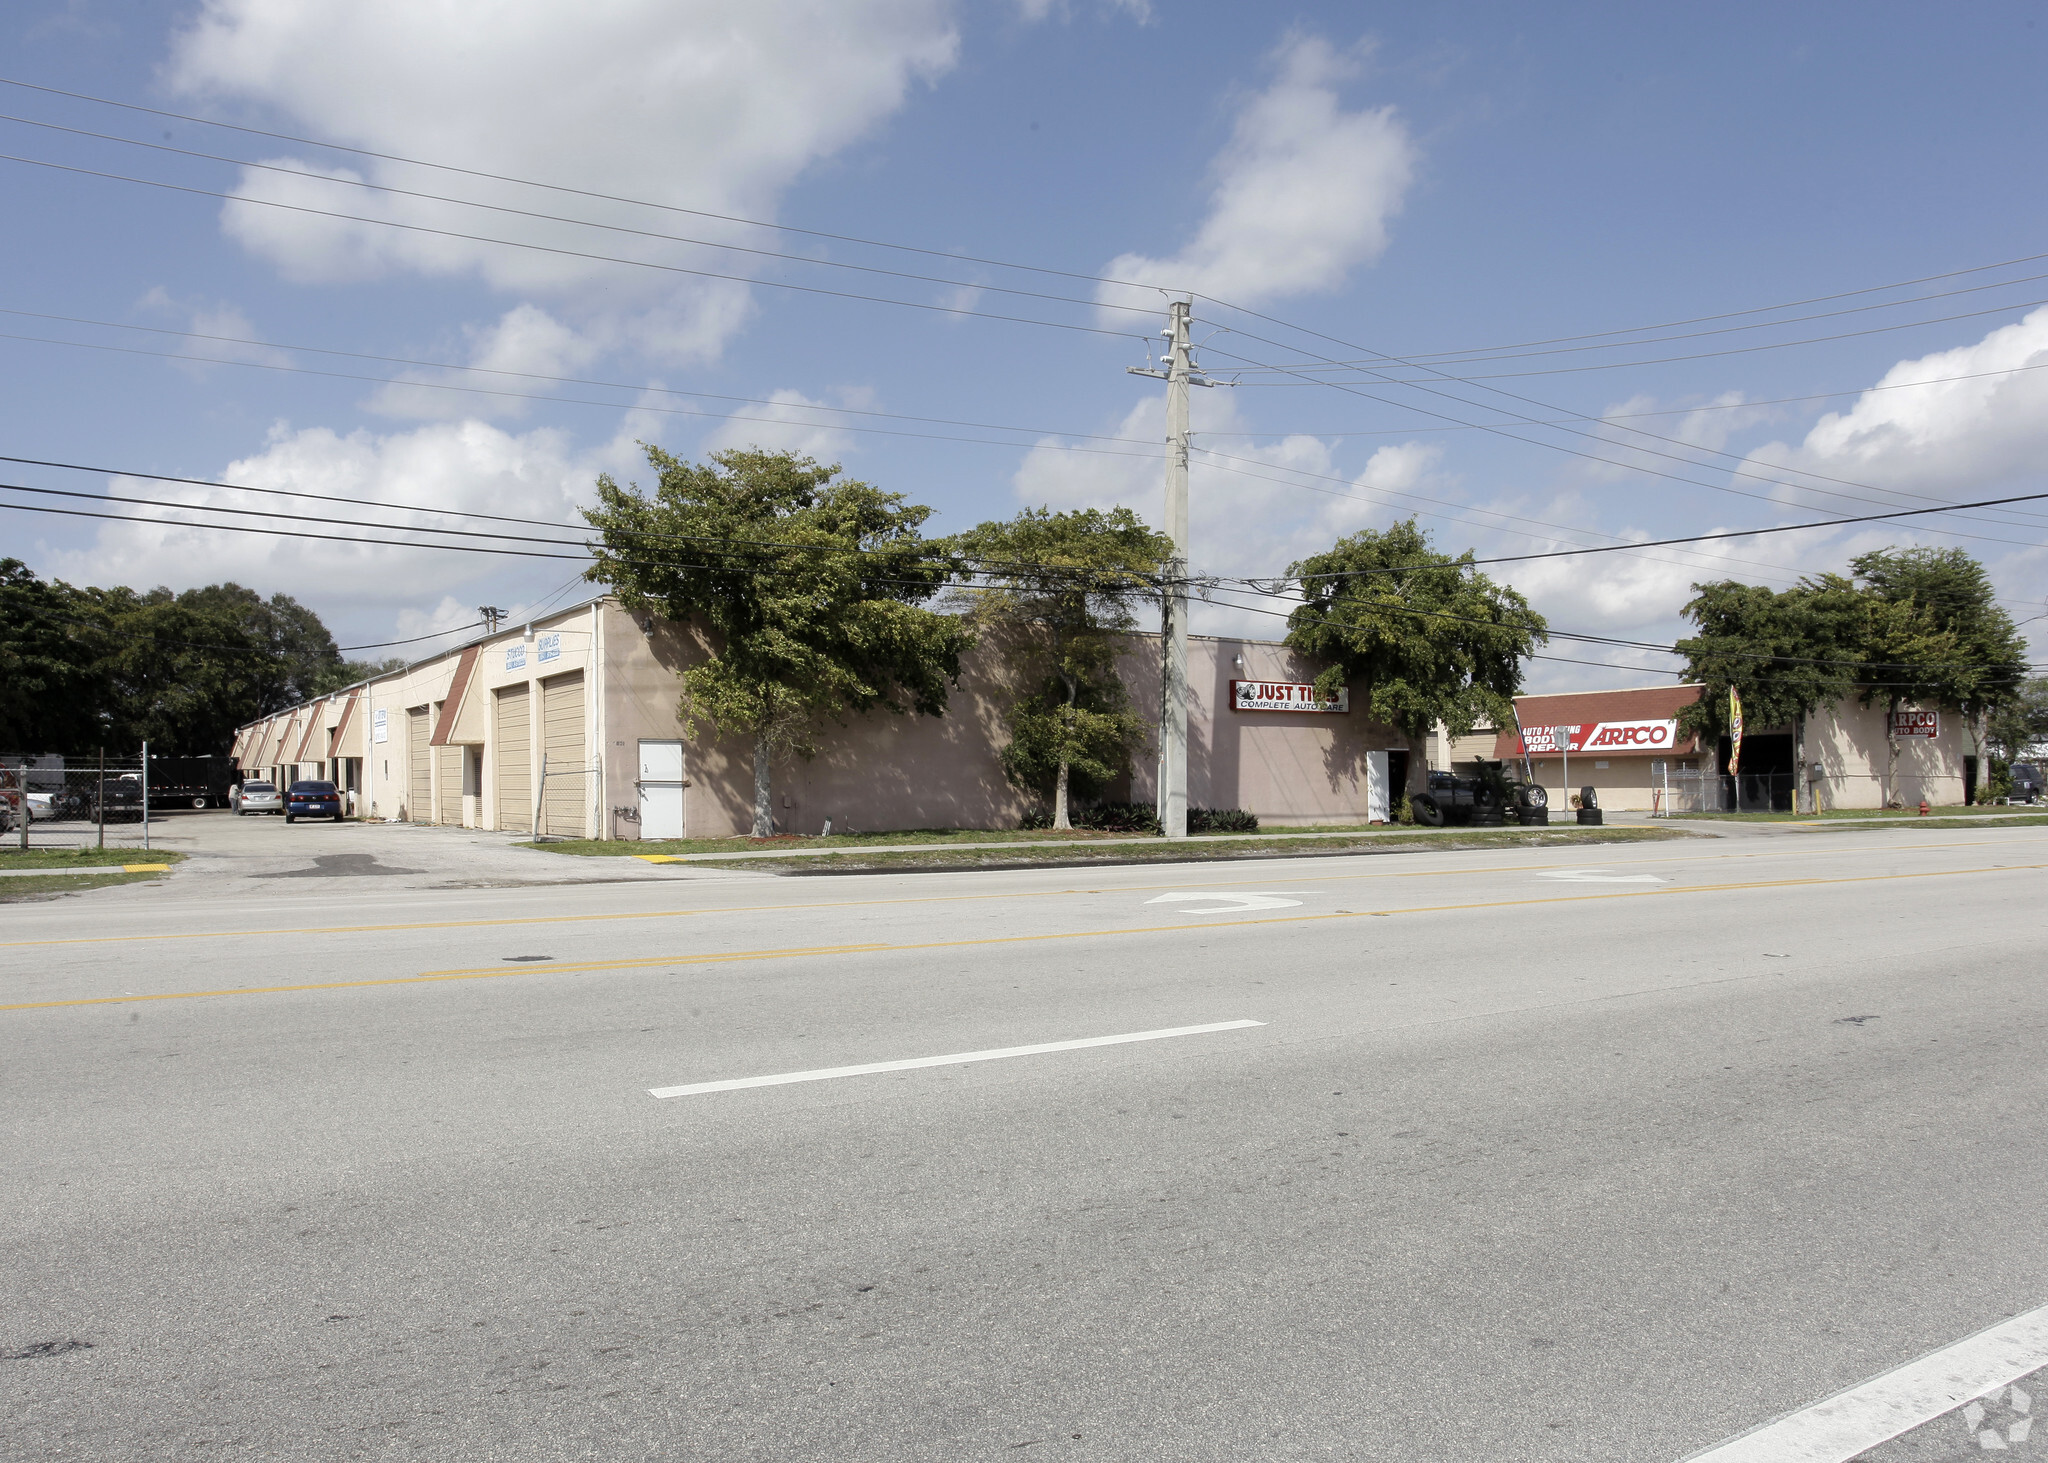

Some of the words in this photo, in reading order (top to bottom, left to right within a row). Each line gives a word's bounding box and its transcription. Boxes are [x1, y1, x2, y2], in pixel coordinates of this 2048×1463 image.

[538, 634, 560, 650] SUPPLIES
[1257, 685, 1293, 700] JUST
[1298, 686, 1340, 703] TIS
[1240, 701, 1290, 710] COMPLETE
[1896, 712, 1935, 726] RPCO
[1522, 727, 1543, 736] AUTO
[1544, 725, 1581, 736] PAING
[1590, 725, 1668, 746] ARPCO
[1524, 735, 1556, 745] BODY
[1528, 743, 1579, 752] REPR
